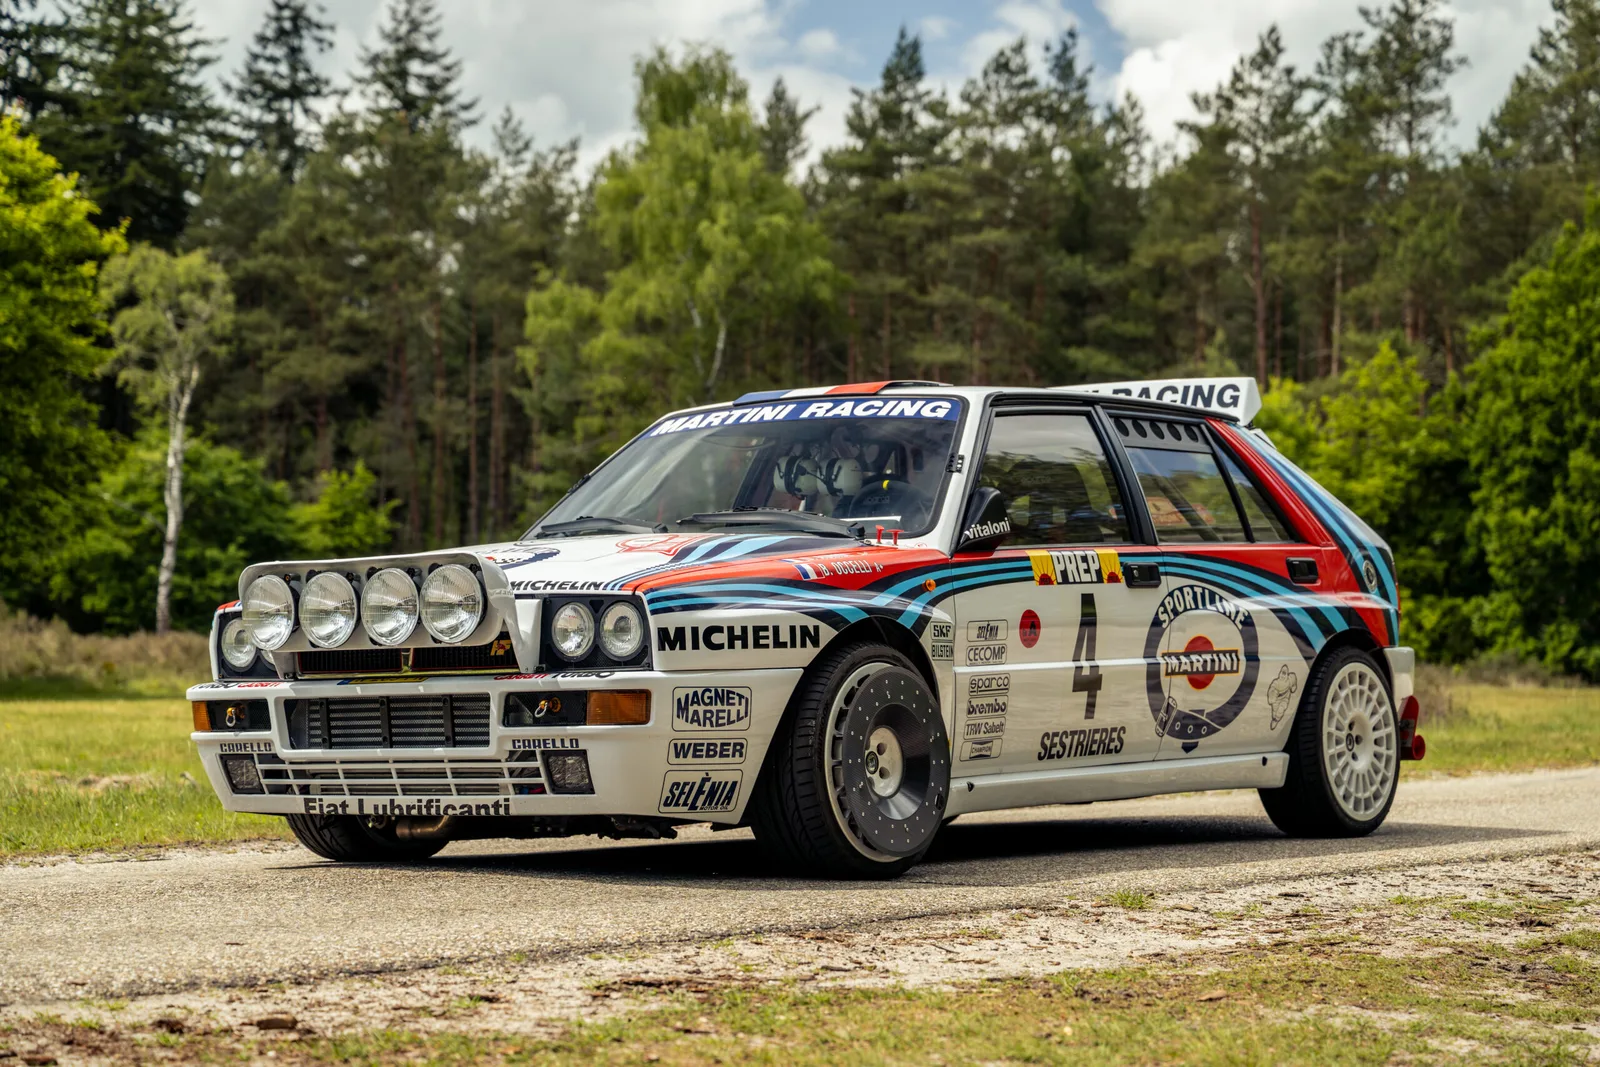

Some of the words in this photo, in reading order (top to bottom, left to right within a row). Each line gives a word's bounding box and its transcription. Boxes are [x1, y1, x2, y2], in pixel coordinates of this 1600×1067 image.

[650, 404, 797, 437] MARTINI
[799, 400, 952, 419] RACING
[964, 517, 1011, 539] vitaloni
[831, 559, 872, 575] OCCELLI
[1048, 550, 1101, 583] PREP
[510, 580, 605, 591] MICHELIN
[1158, 586, 1248, 630] SPORTLINE
[657, 625, 820, 652] MICHELIN
[933, 625, 951, 638] SKF
[967, 645, 1006, 662] CECOMP
[1072, 593, 1103, 720] 4
[1164, 652, 1239, 673] MARTINI
[970, 676, 1010, 694] sparco
[967, 698, 1007, 715] brembo
[966, 722, 983, 735] TRW
[983, 721, 1005, 734] Sabelt
[220, 742, 272, 753] CARELLO
[512, 738, 580, 749] CARELLO
[673, 742, 745, 759] WEBER
[1037, 726, 1126, 761] SESTRIERES
[303, 797, 350, 816] Fiat
[357, 797, 511, 816] Lubrificanti
